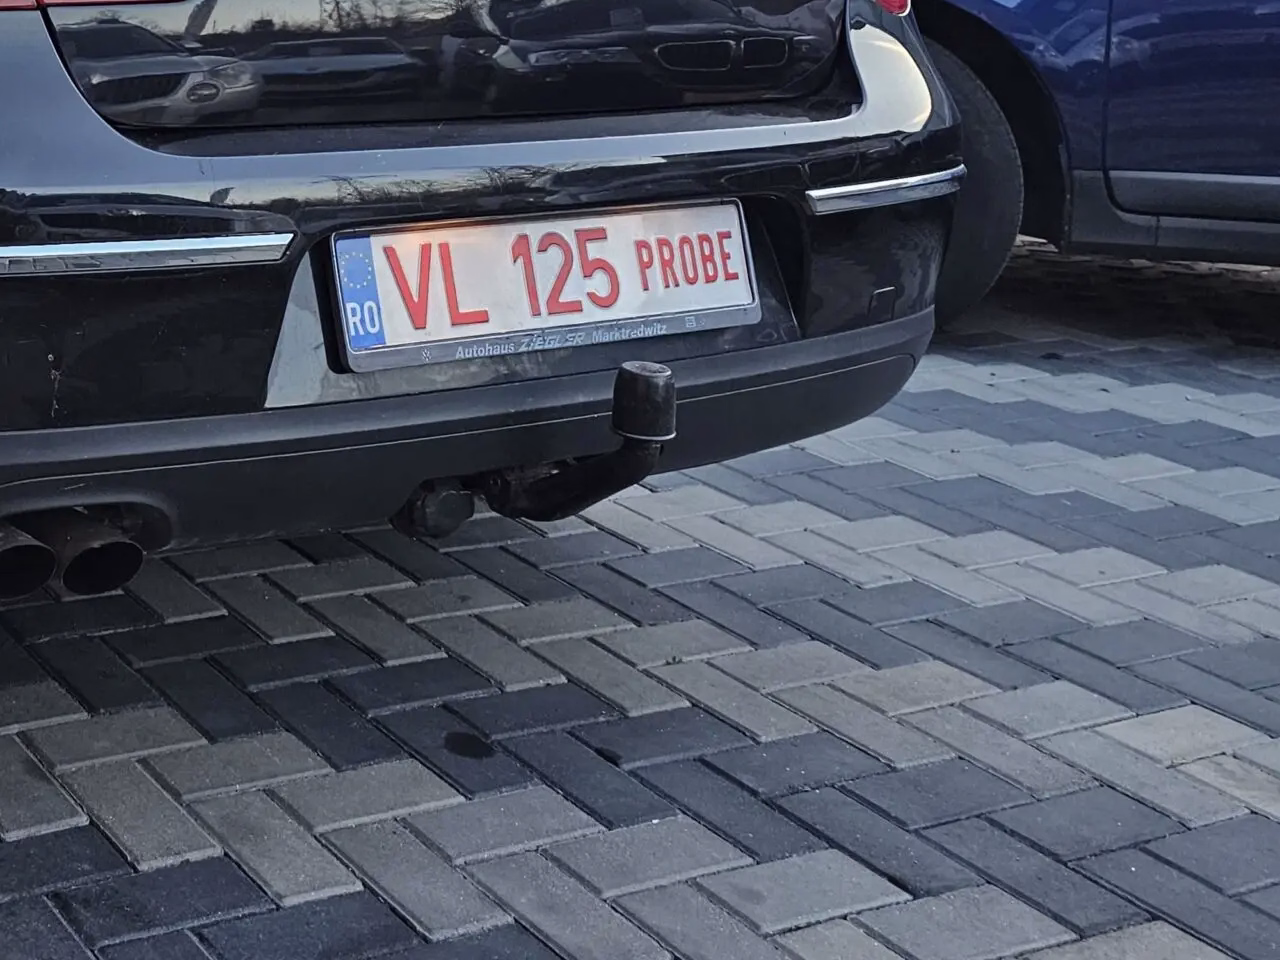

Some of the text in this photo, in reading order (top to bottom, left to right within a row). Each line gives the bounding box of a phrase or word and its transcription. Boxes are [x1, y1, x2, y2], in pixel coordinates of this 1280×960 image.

[382, 225, 740, 330] VL 125 PROBE
[345, 300, 381, 337] RO
[455, 340, 515, 360] Autohaus
[591, 323, 668, 344] Marktredwitz
